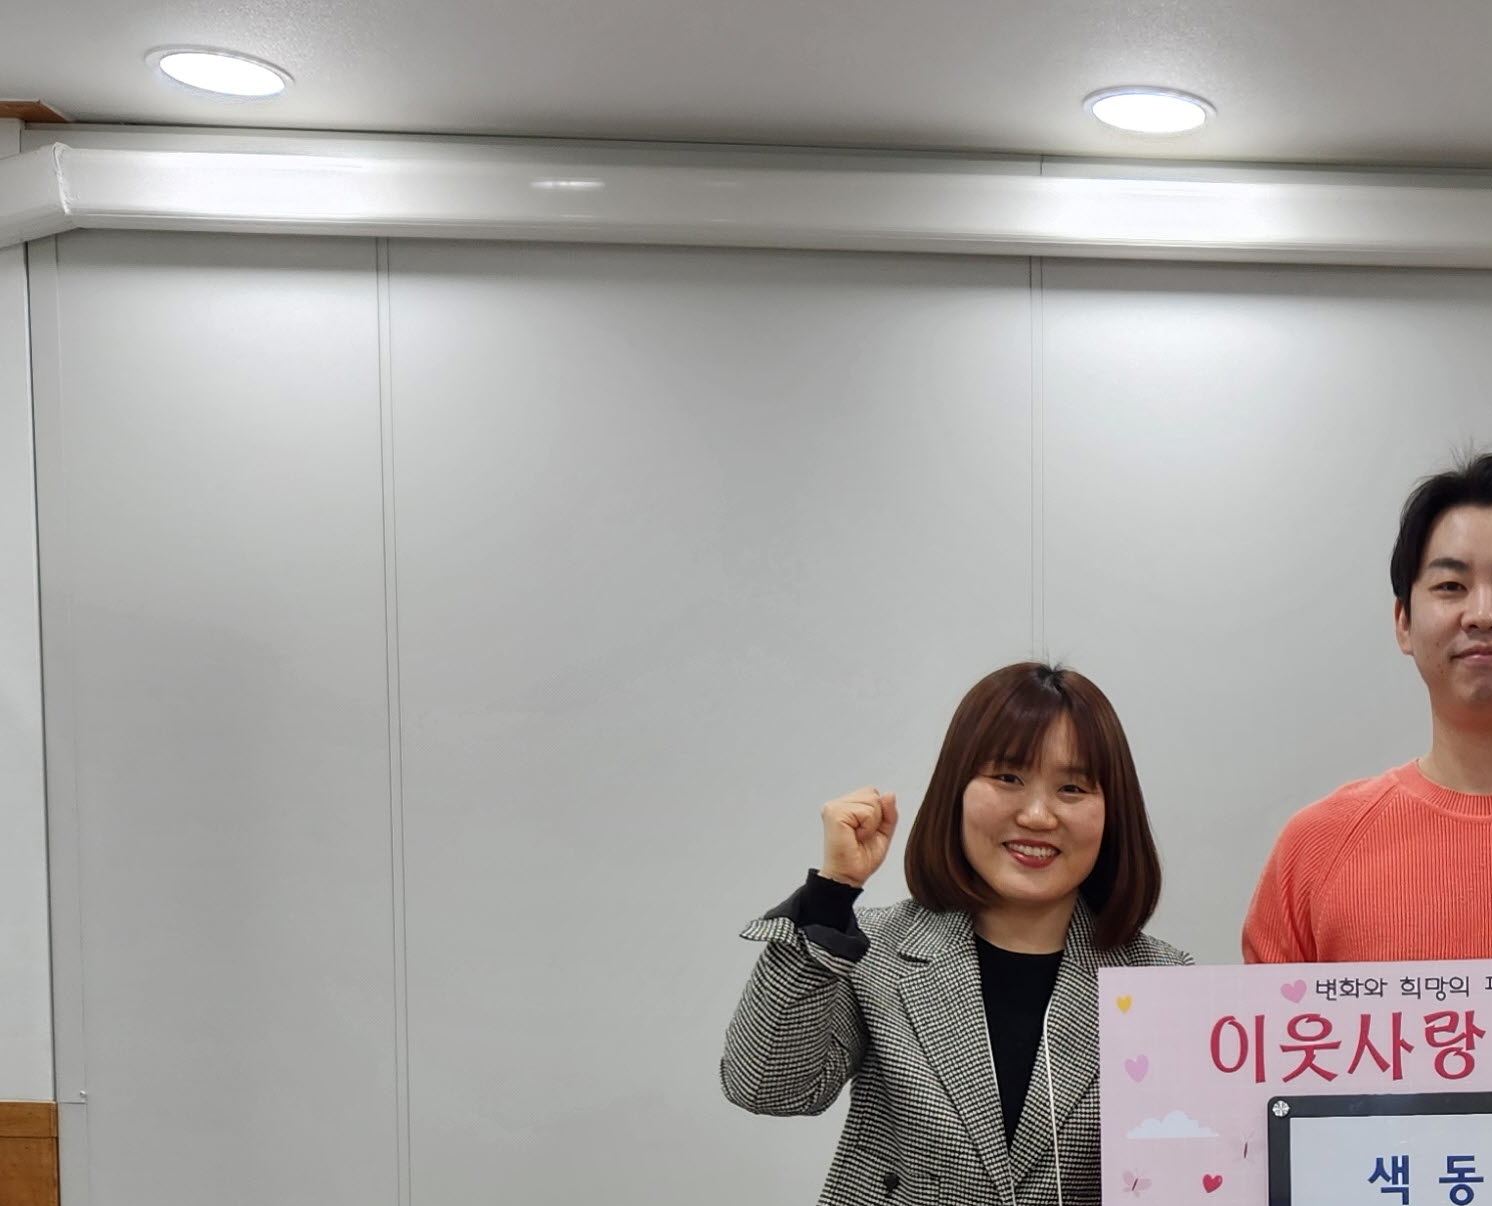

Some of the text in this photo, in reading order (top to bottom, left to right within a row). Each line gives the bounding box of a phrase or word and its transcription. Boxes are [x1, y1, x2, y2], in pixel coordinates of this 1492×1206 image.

[1315, 977, 1388, 1001] 변화와
[1400, 976, 1470, 1001] 희망의
[1210, 1010, 1486, 1083] 이웃사랑
